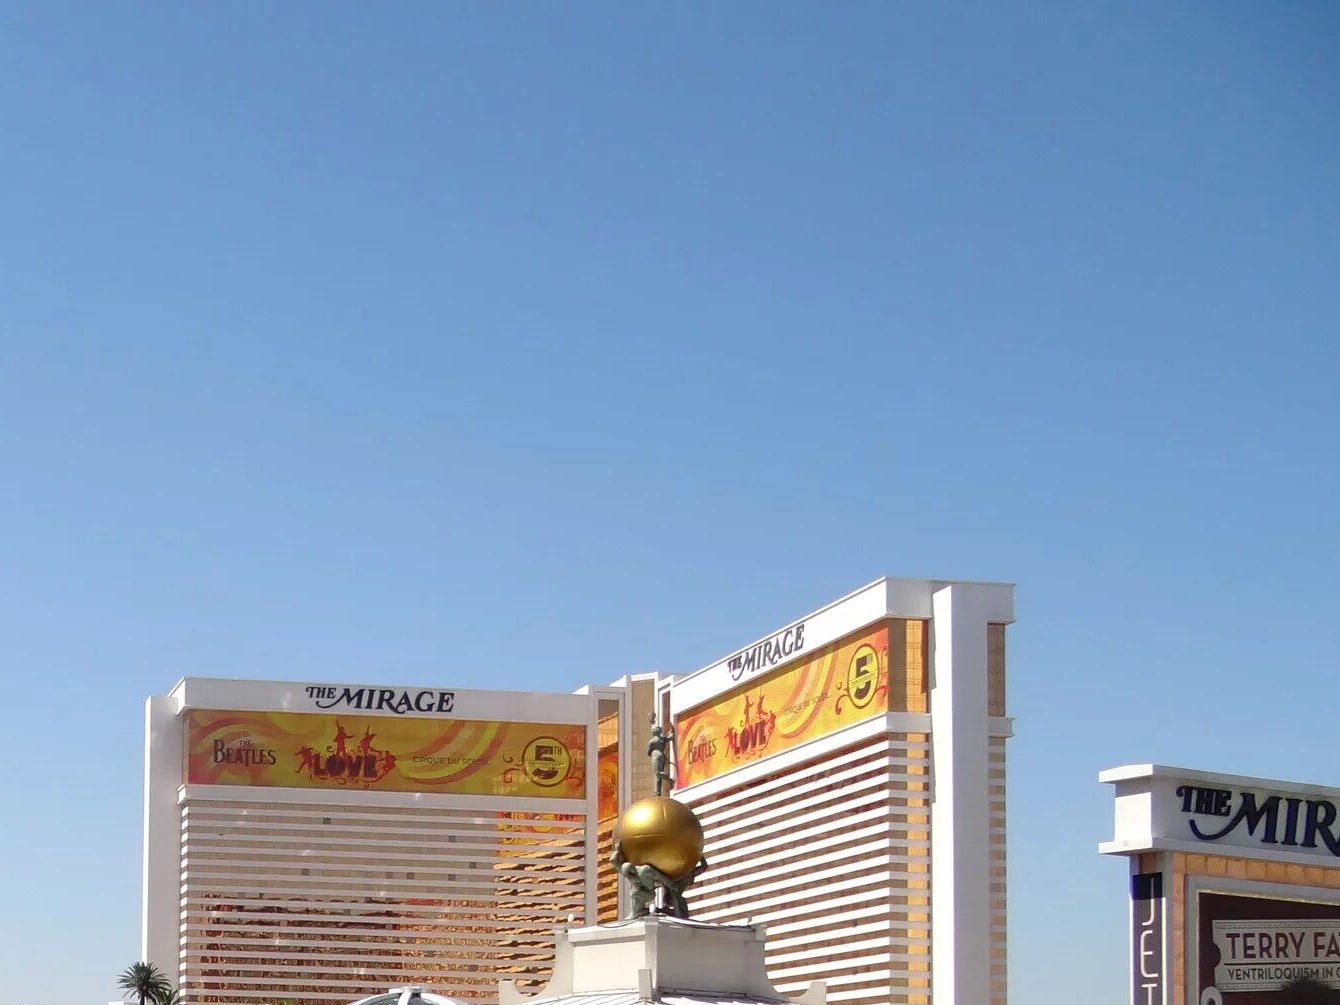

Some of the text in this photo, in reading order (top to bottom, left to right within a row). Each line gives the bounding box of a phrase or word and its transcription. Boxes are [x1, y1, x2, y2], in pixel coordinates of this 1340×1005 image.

[727, 623, 805, 681] THE MIRAGE
[305, 686, 455, 715] THE MIRAGE
[733, 719, 768, 756] LOVE
[213, 739, 277, 768] BEATLES
[312, 752, 379, 779] LOVE
[412, 755, 447, 766] CIRQUE
[1175, 785, 1340, 859] THE MIR
[1225, 931, 1340, 959] TERRY FA
[1227, 967, 1320, 980] VENTRILOQUISM
[1321, 967, 1333, 979] IN
